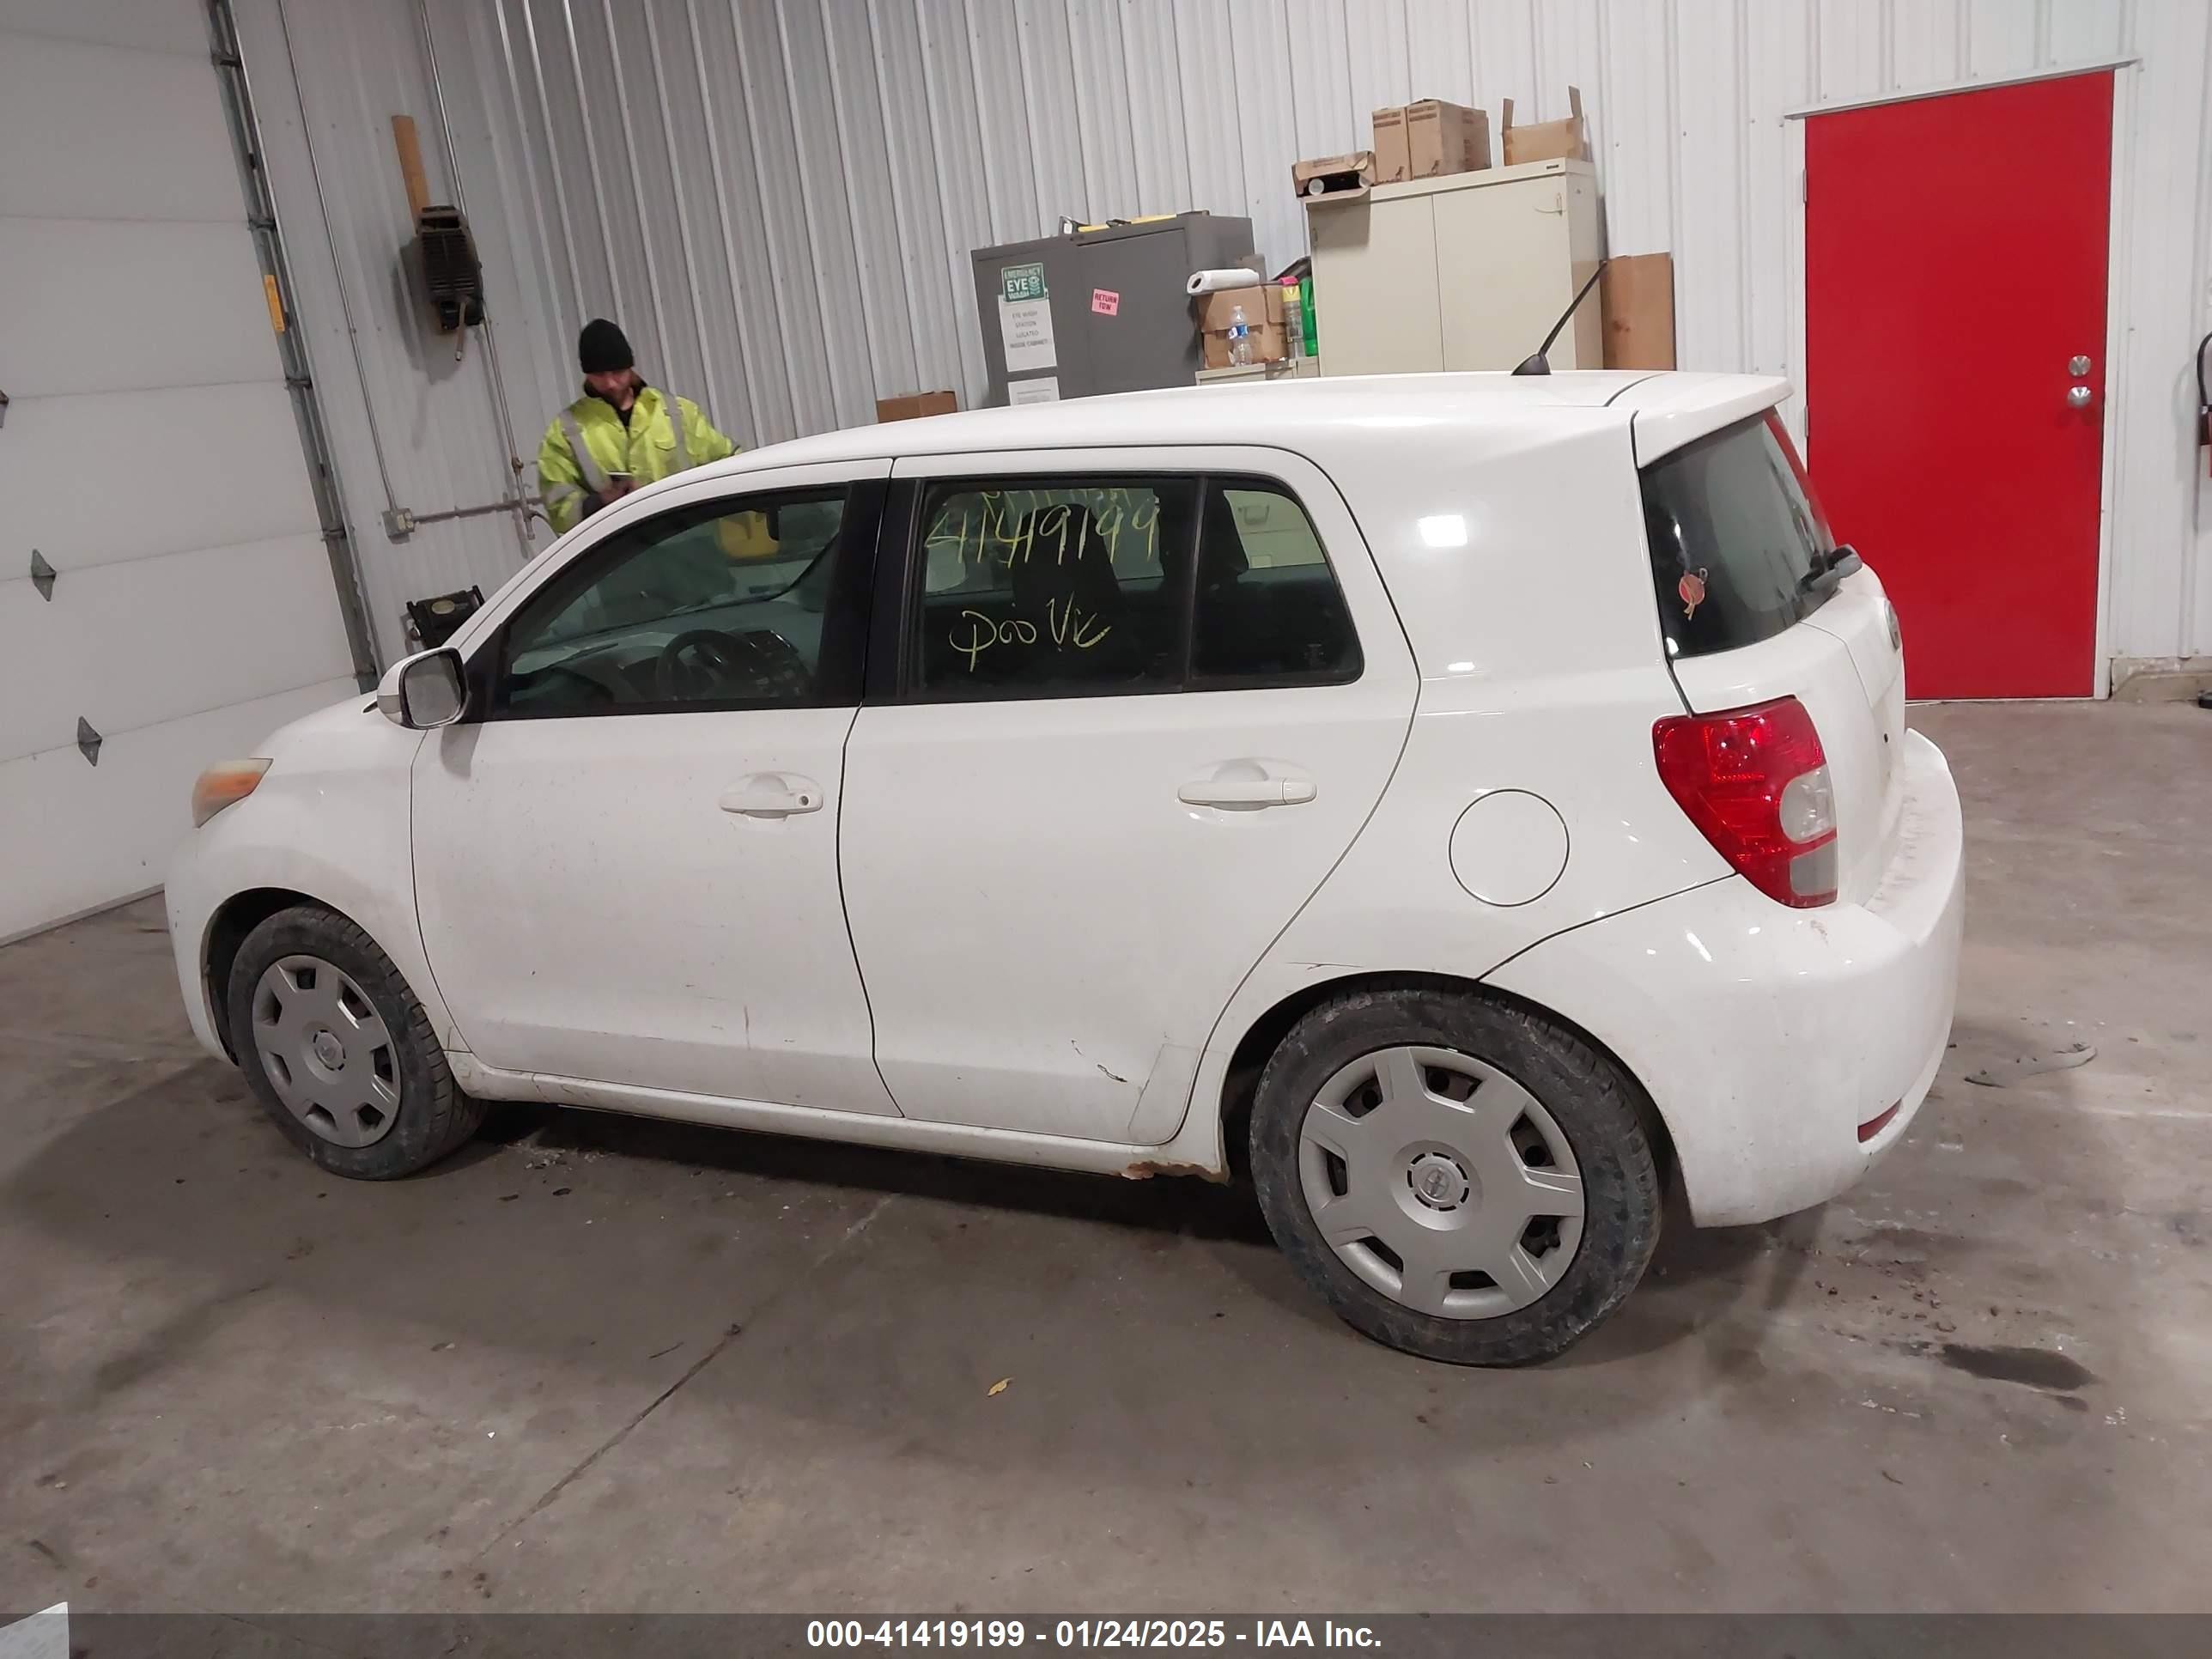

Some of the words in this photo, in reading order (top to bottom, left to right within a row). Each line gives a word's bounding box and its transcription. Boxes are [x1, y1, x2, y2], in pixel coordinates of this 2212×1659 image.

[1006, 277, 1029, 292] EYE
[1094, 293, 1117, 303] RETURN
[1099, 301, 1112, 310] TOW
[925, 504, 1160, 568] 41419199
